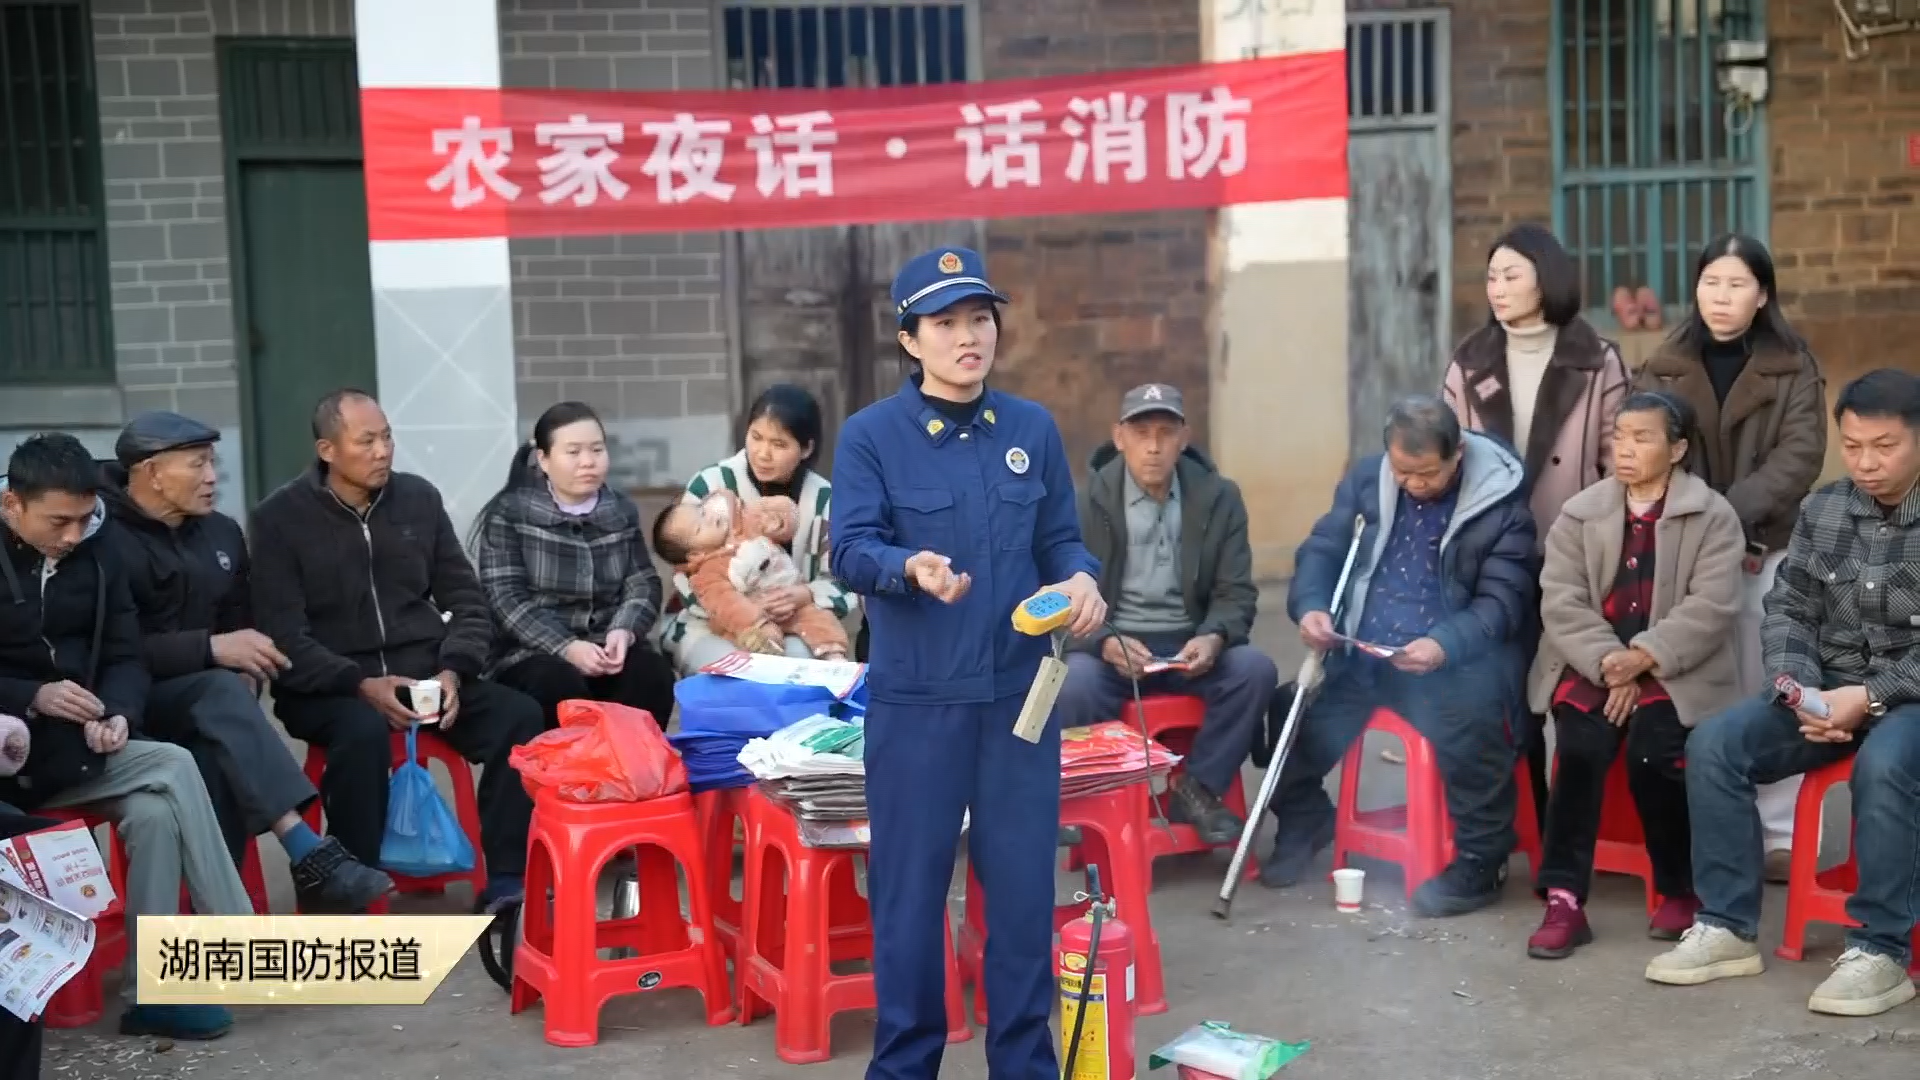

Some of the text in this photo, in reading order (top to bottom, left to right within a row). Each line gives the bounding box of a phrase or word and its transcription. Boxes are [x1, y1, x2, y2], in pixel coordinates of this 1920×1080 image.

[427, 87, 1253, 210] 农家夜话·话消防
[1143, 386, 1163, 400] A
